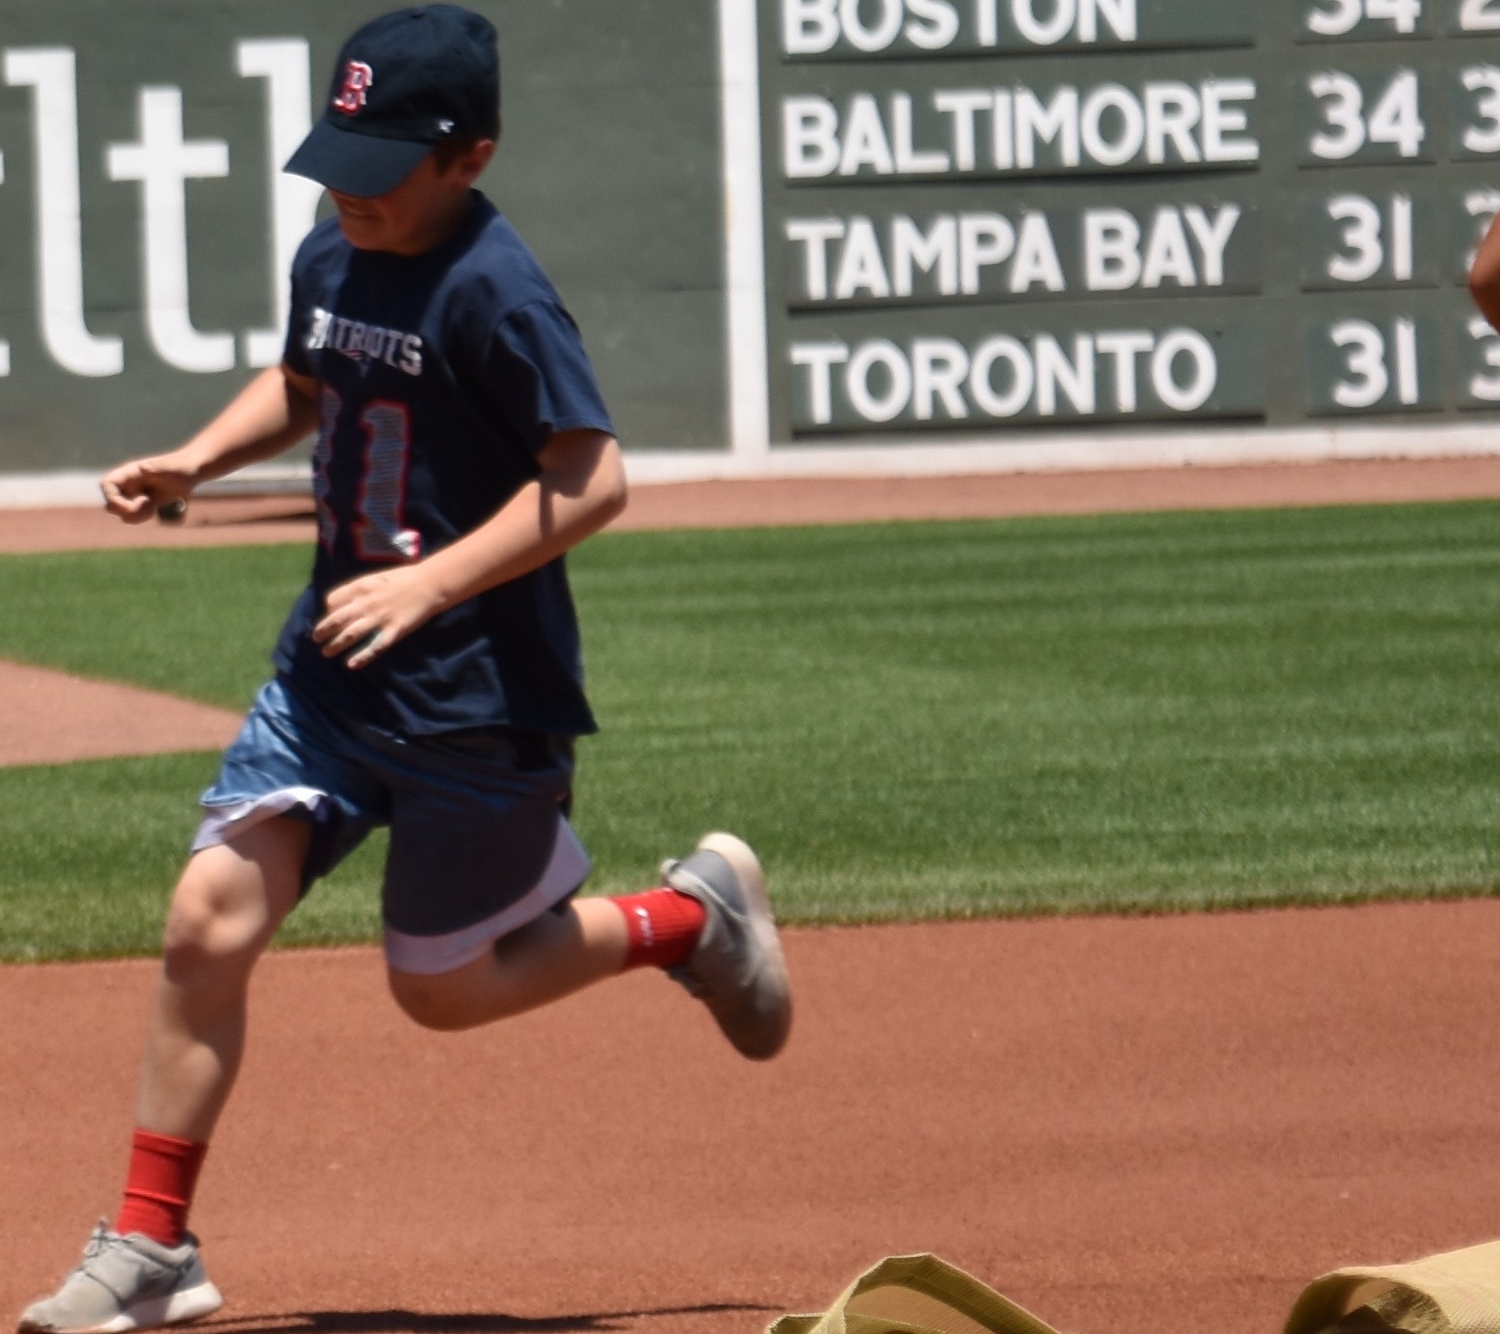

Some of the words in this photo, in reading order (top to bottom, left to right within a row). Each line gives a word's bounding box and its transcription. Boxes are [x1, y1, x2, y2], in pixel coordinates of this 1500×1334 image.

[333, 60, 374, 117] B
[781, 79, 1260, 179] BALTIMORE
[1308, 70, 1426, 160] 34
[784, 212, 1065, 301] TAMPA
[1082, 204, 1241, 292] BAY
[1326, 194, 1413, 282] 31
[788, 328, 1218, 425] TORONTO
[1329, 319, 1419, 408] 31
